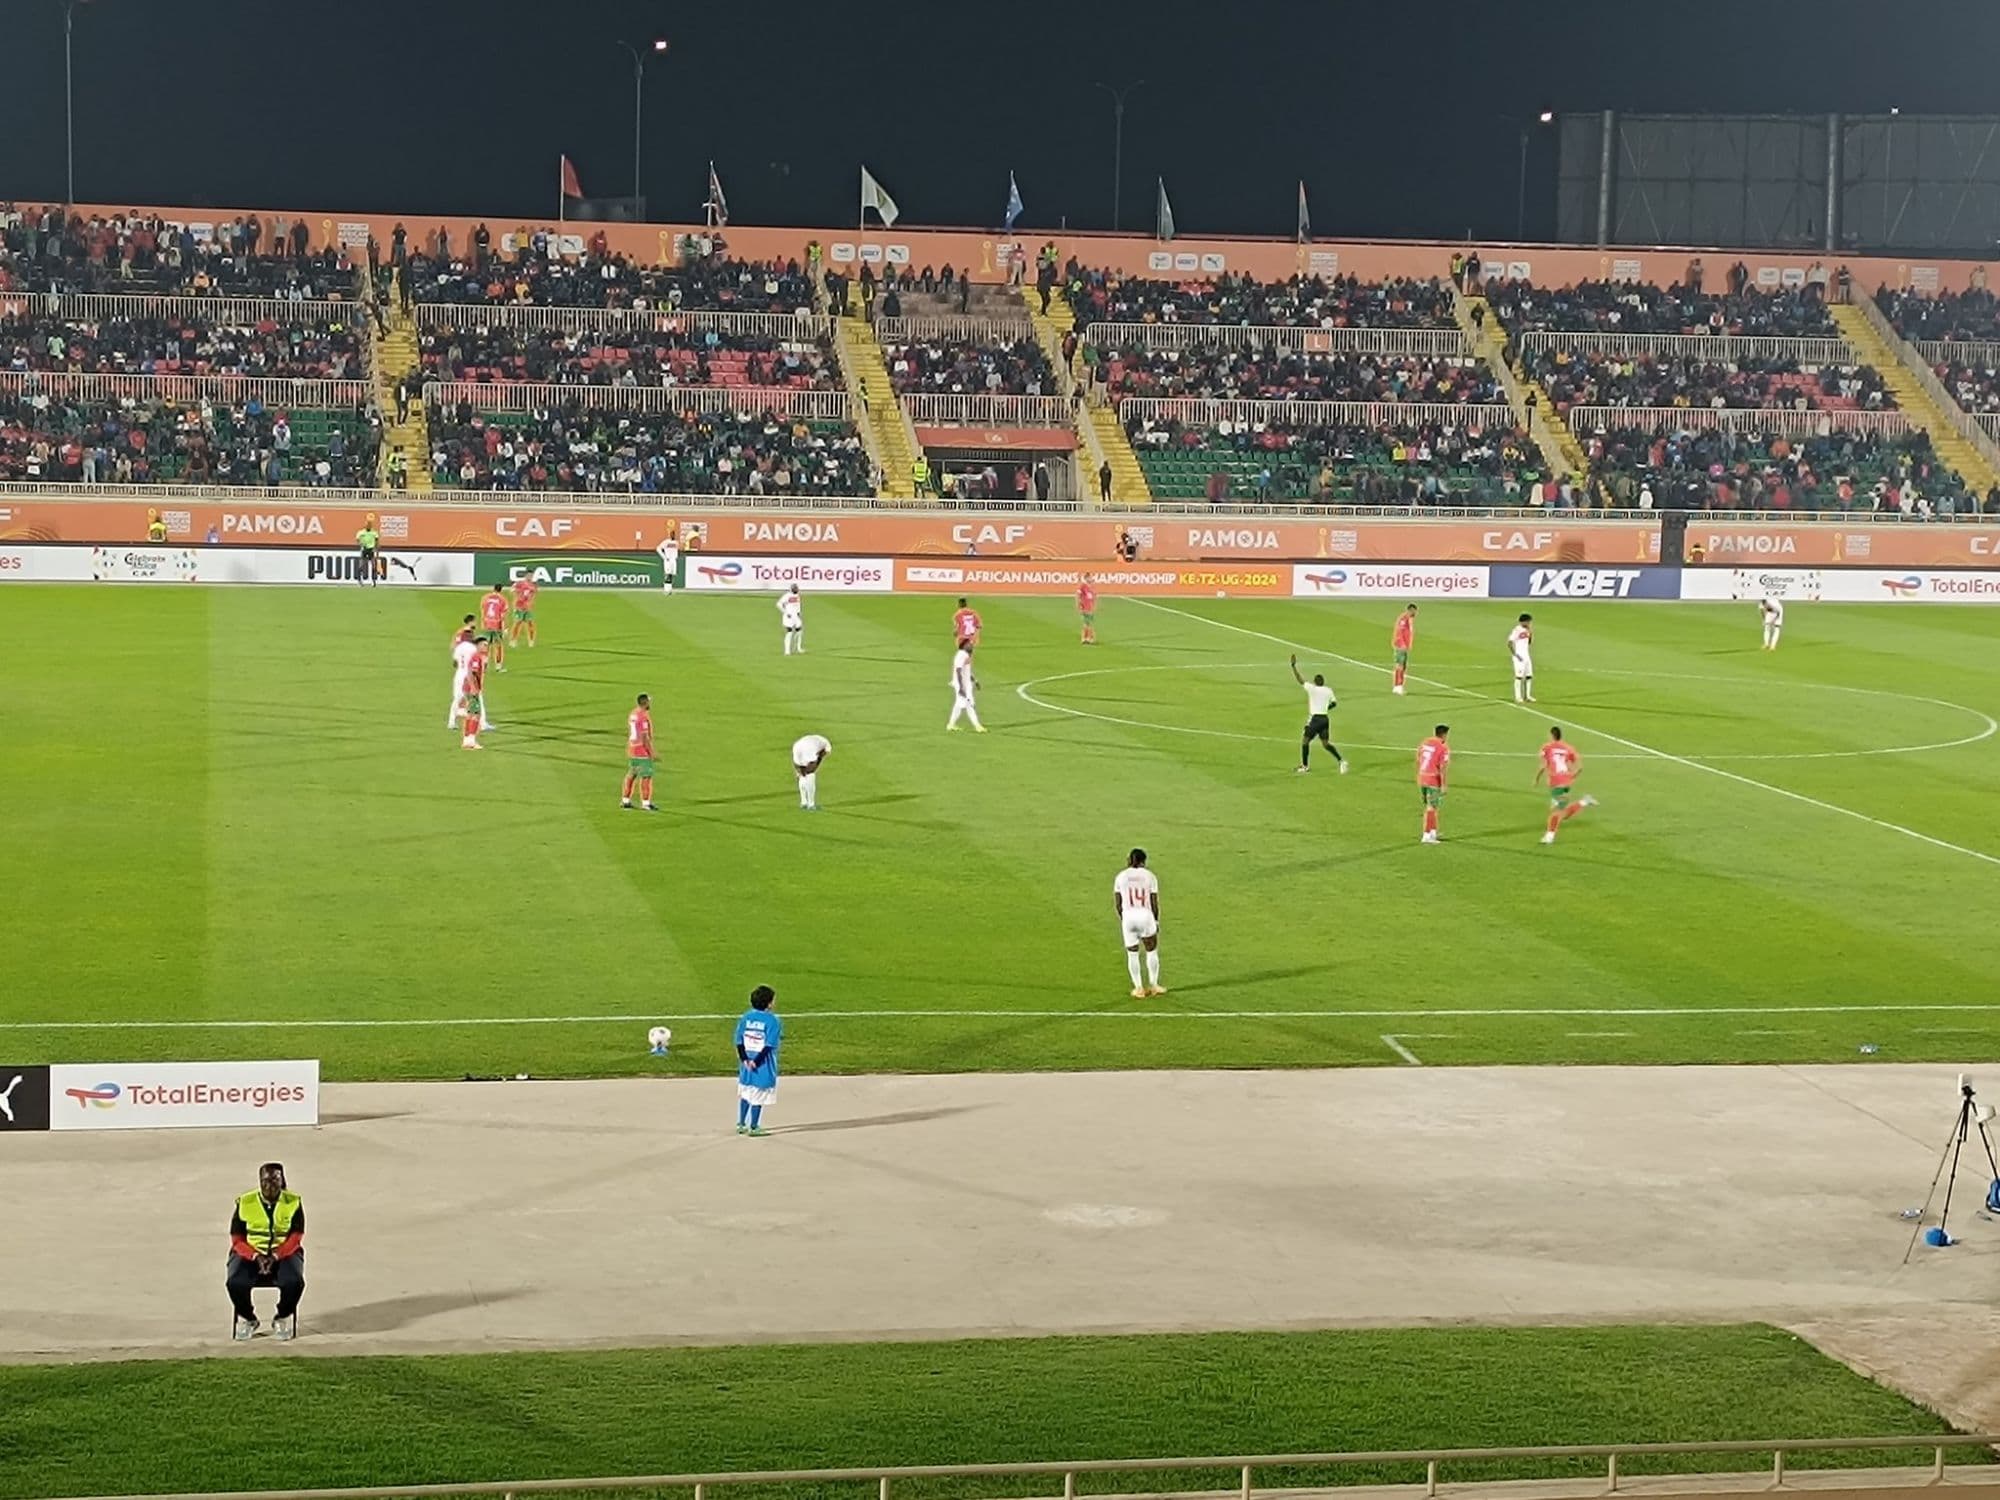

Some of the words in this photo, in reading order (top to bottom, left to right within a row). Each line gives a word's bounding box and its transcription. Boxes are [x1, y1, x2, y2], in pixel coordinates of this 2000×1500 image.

[222, 514, 323, 534] PAMOJA
[495, 517, 573, 537] CAF
[743, 522, 838, 542] PAMOJA
[952, 525, 1026, 543] CAF
[1188, 529, 1278, 549] PAMOJA
[1483, 532, 1552, 550] CAF
[1709, 535, 1796, 553] PAMOJA
[752, 564, 881, 584] TotalEnergies
[964, 570, 1022, 584] AFRICAN
[1023, 571, 1079, 585] NATIONS
[1356, 572, 1479, 592] TotalEnergies
[1529, 569, 1641, 597] 1XBET
[1129, 887, 1147, 907] 14
[128, 1082, 304, 1107] TotalEnergies
